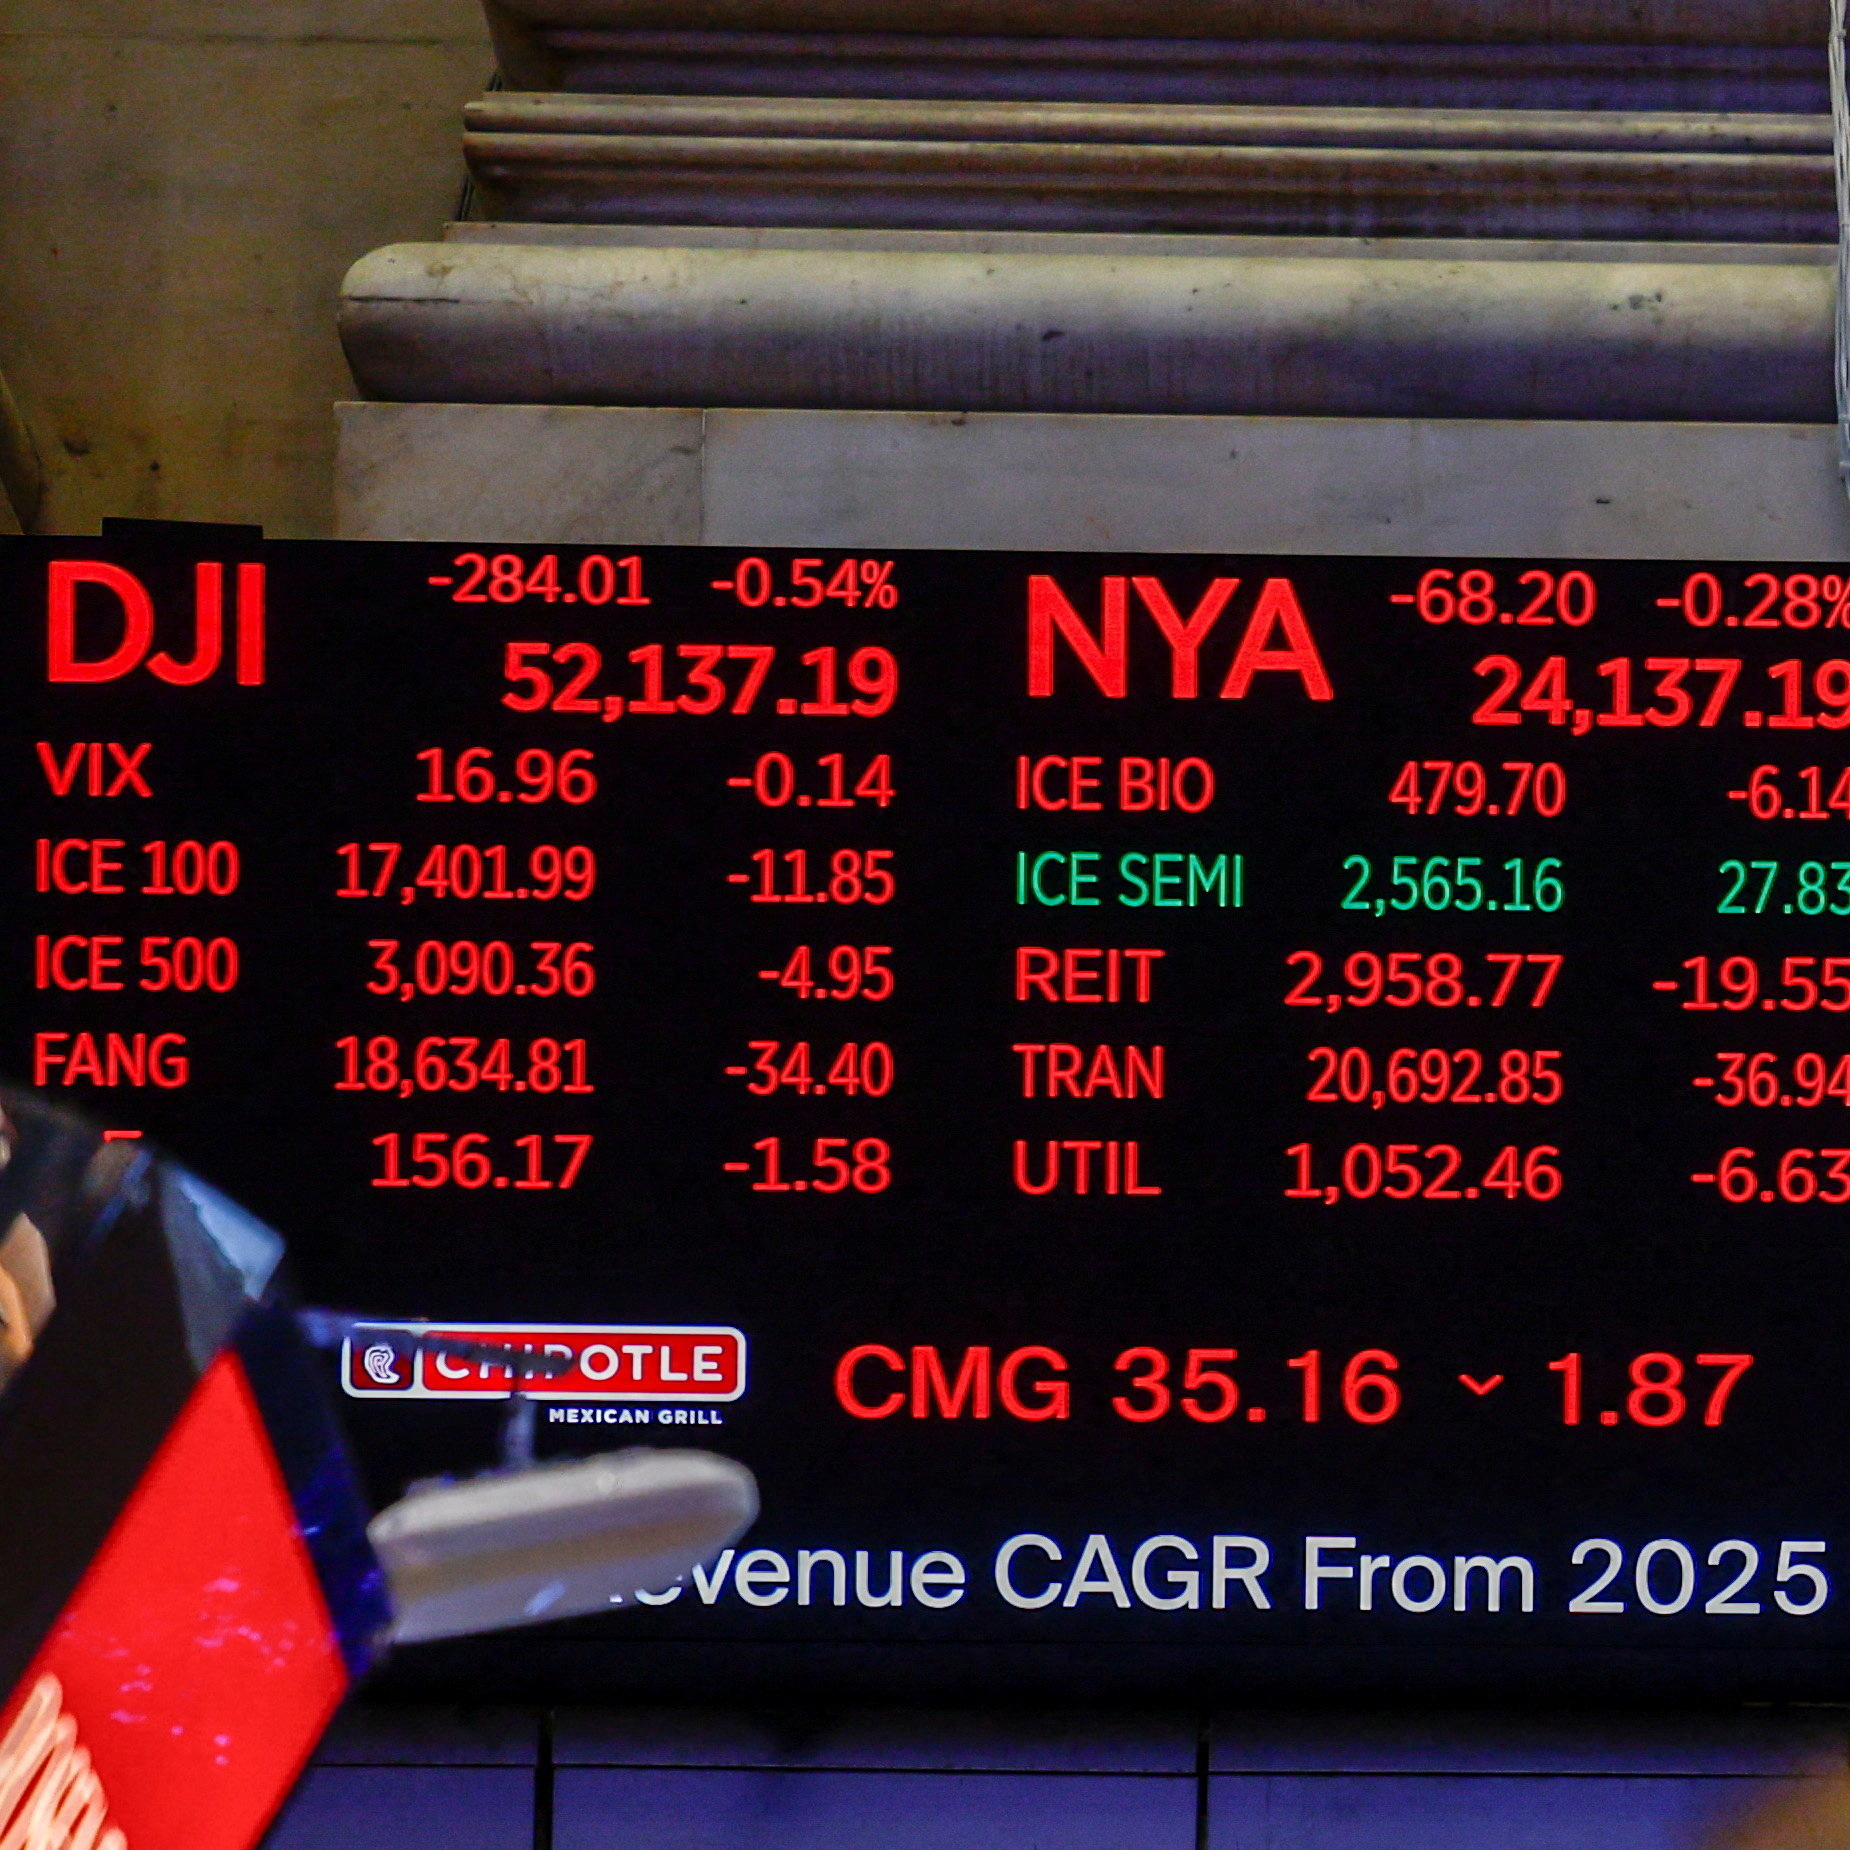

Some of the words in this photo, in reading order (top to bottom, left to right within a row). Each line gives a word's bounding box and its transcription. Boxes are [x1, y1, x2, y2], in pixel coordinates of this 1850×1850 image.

[428, 552, 651, 605] -284.01
[711, 557, 898, 609] -0.54%
[1389, 569, 1596, 626] -68.20
[48, 560, 265, 686] DJI
[1028, 575, 1333, 701] NYA
[501, 642, 898, 722] 52,137.19
[36, 742, 153, 797] VIX
[416, 747, 597, 804] 16.96
[727, 751, 896, 808] -0.14
[1017, 755, 1103, 811] ICE
[1120, 757, 1214, 813] BIO
[1389, 761, 1566, 817] 479.70
[37, 839, 125, 894] ICE
[141, 840, 239, 896] 100
[337, 843, 596, 905] 17,401.99
[727, 849, 895, 905] -11.85
[1017, 851, 1101, 906] ICE
[1119, 853, 1241, 907] SEMI
[1341, 855, 1562, 917] 2,565.16
[36, 935, 124, 990] ICE
[139, 936, 238, 992] 500
[367, 939, 595, 1002] 3,090.36
[759, 945, 894, 1001] -4.95
[1016, 947, 1165, 1003] REIT
[1284, 951, 1563, 1013] 2,958.77
[34, 1032, 188, 1089] FANG
[334, 1035, 594, 1098] 18,634.81
[725, 1041, 893, 1097] -34.40
[1012, 1043, 1164, 1099] TRAN
[1306, 1047, 1563, 1110] 20,692.85
[371, 1133, 593, 1189] 156.17
[723, 1137, 891, 1193] -1.58
[1014, 1140, 1161, 1196] UTIL
[1285, 1143, 1562, 1205] 1,052.46
[549, 1407, 651, 1423] MEXICAN
[658, 1408, 722, 1424] GRILL
[835, 1344, 1069, 1421] CMG
[1112, 1347, 1401, 1424] 35.16
[1549, 1352, 1753, 1426] 1.87
[609, 1540, 968, 1610] venue
[995, 1534, 1272, 1610] CAGR
[1305, 1535, 1535, 1612] From
[1569, 1537, 1831, 1615] 2025
